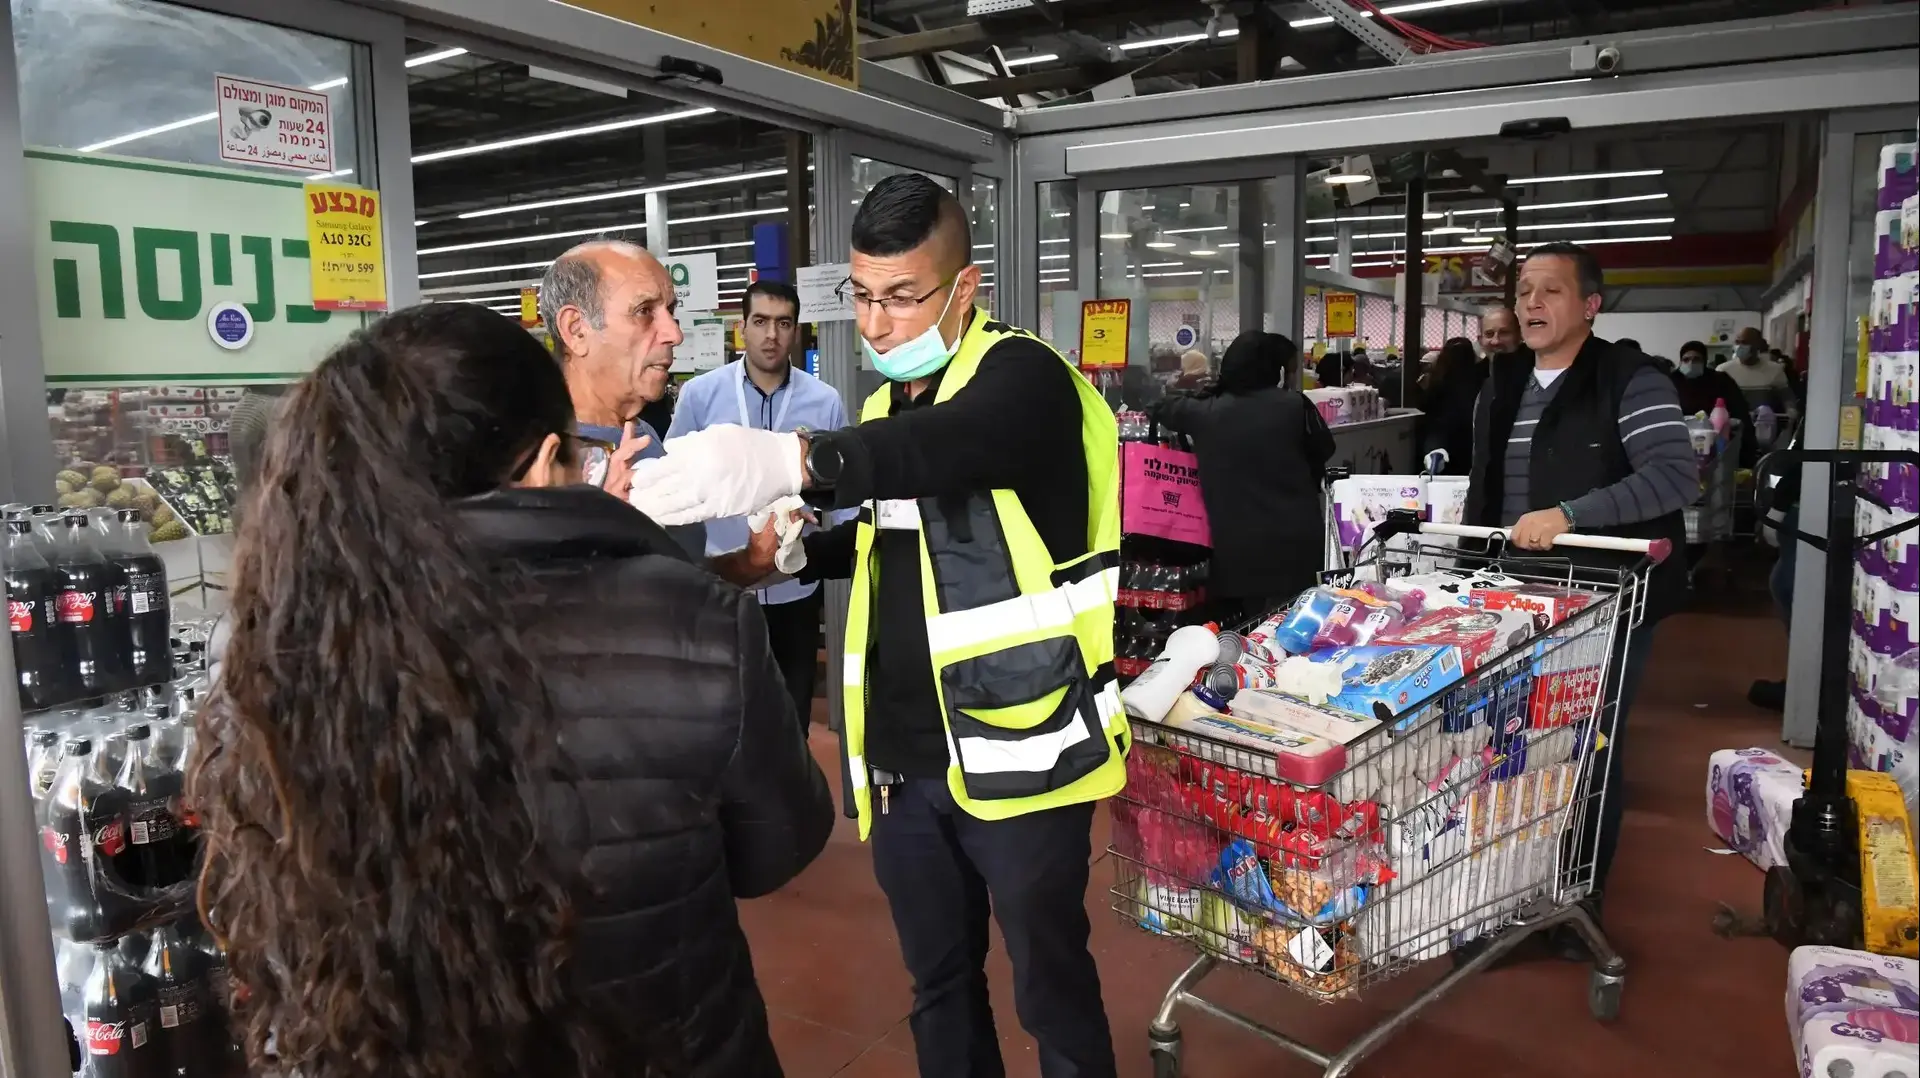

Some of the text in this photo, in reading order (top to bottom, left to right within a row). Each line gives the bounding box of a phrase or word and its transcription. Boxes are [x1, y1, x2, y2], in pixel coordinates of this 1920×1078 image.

[223, 84, 324, 114] המקום מוגן ומצולם
[279, 118, 325, 134] 24 שעות
[226, 140, 246, 153] ساعة
[279, 132, 325, 149] ביממה
[248, 144, 258, 156] 24
[309, 191, 376, 218] מבצע
[316, 220, 373, 232] Samsung Galaxy
[320, 232, 371, 247] A10 32G
[358, 263, 374, 274] 599
[1093, 329, 1106, 339] 3
[1143, 457, 1187, 477] רמי לוי
[1143, 470, 1175, 483] השקמה
[1883, 961, 1905, 971] 30
